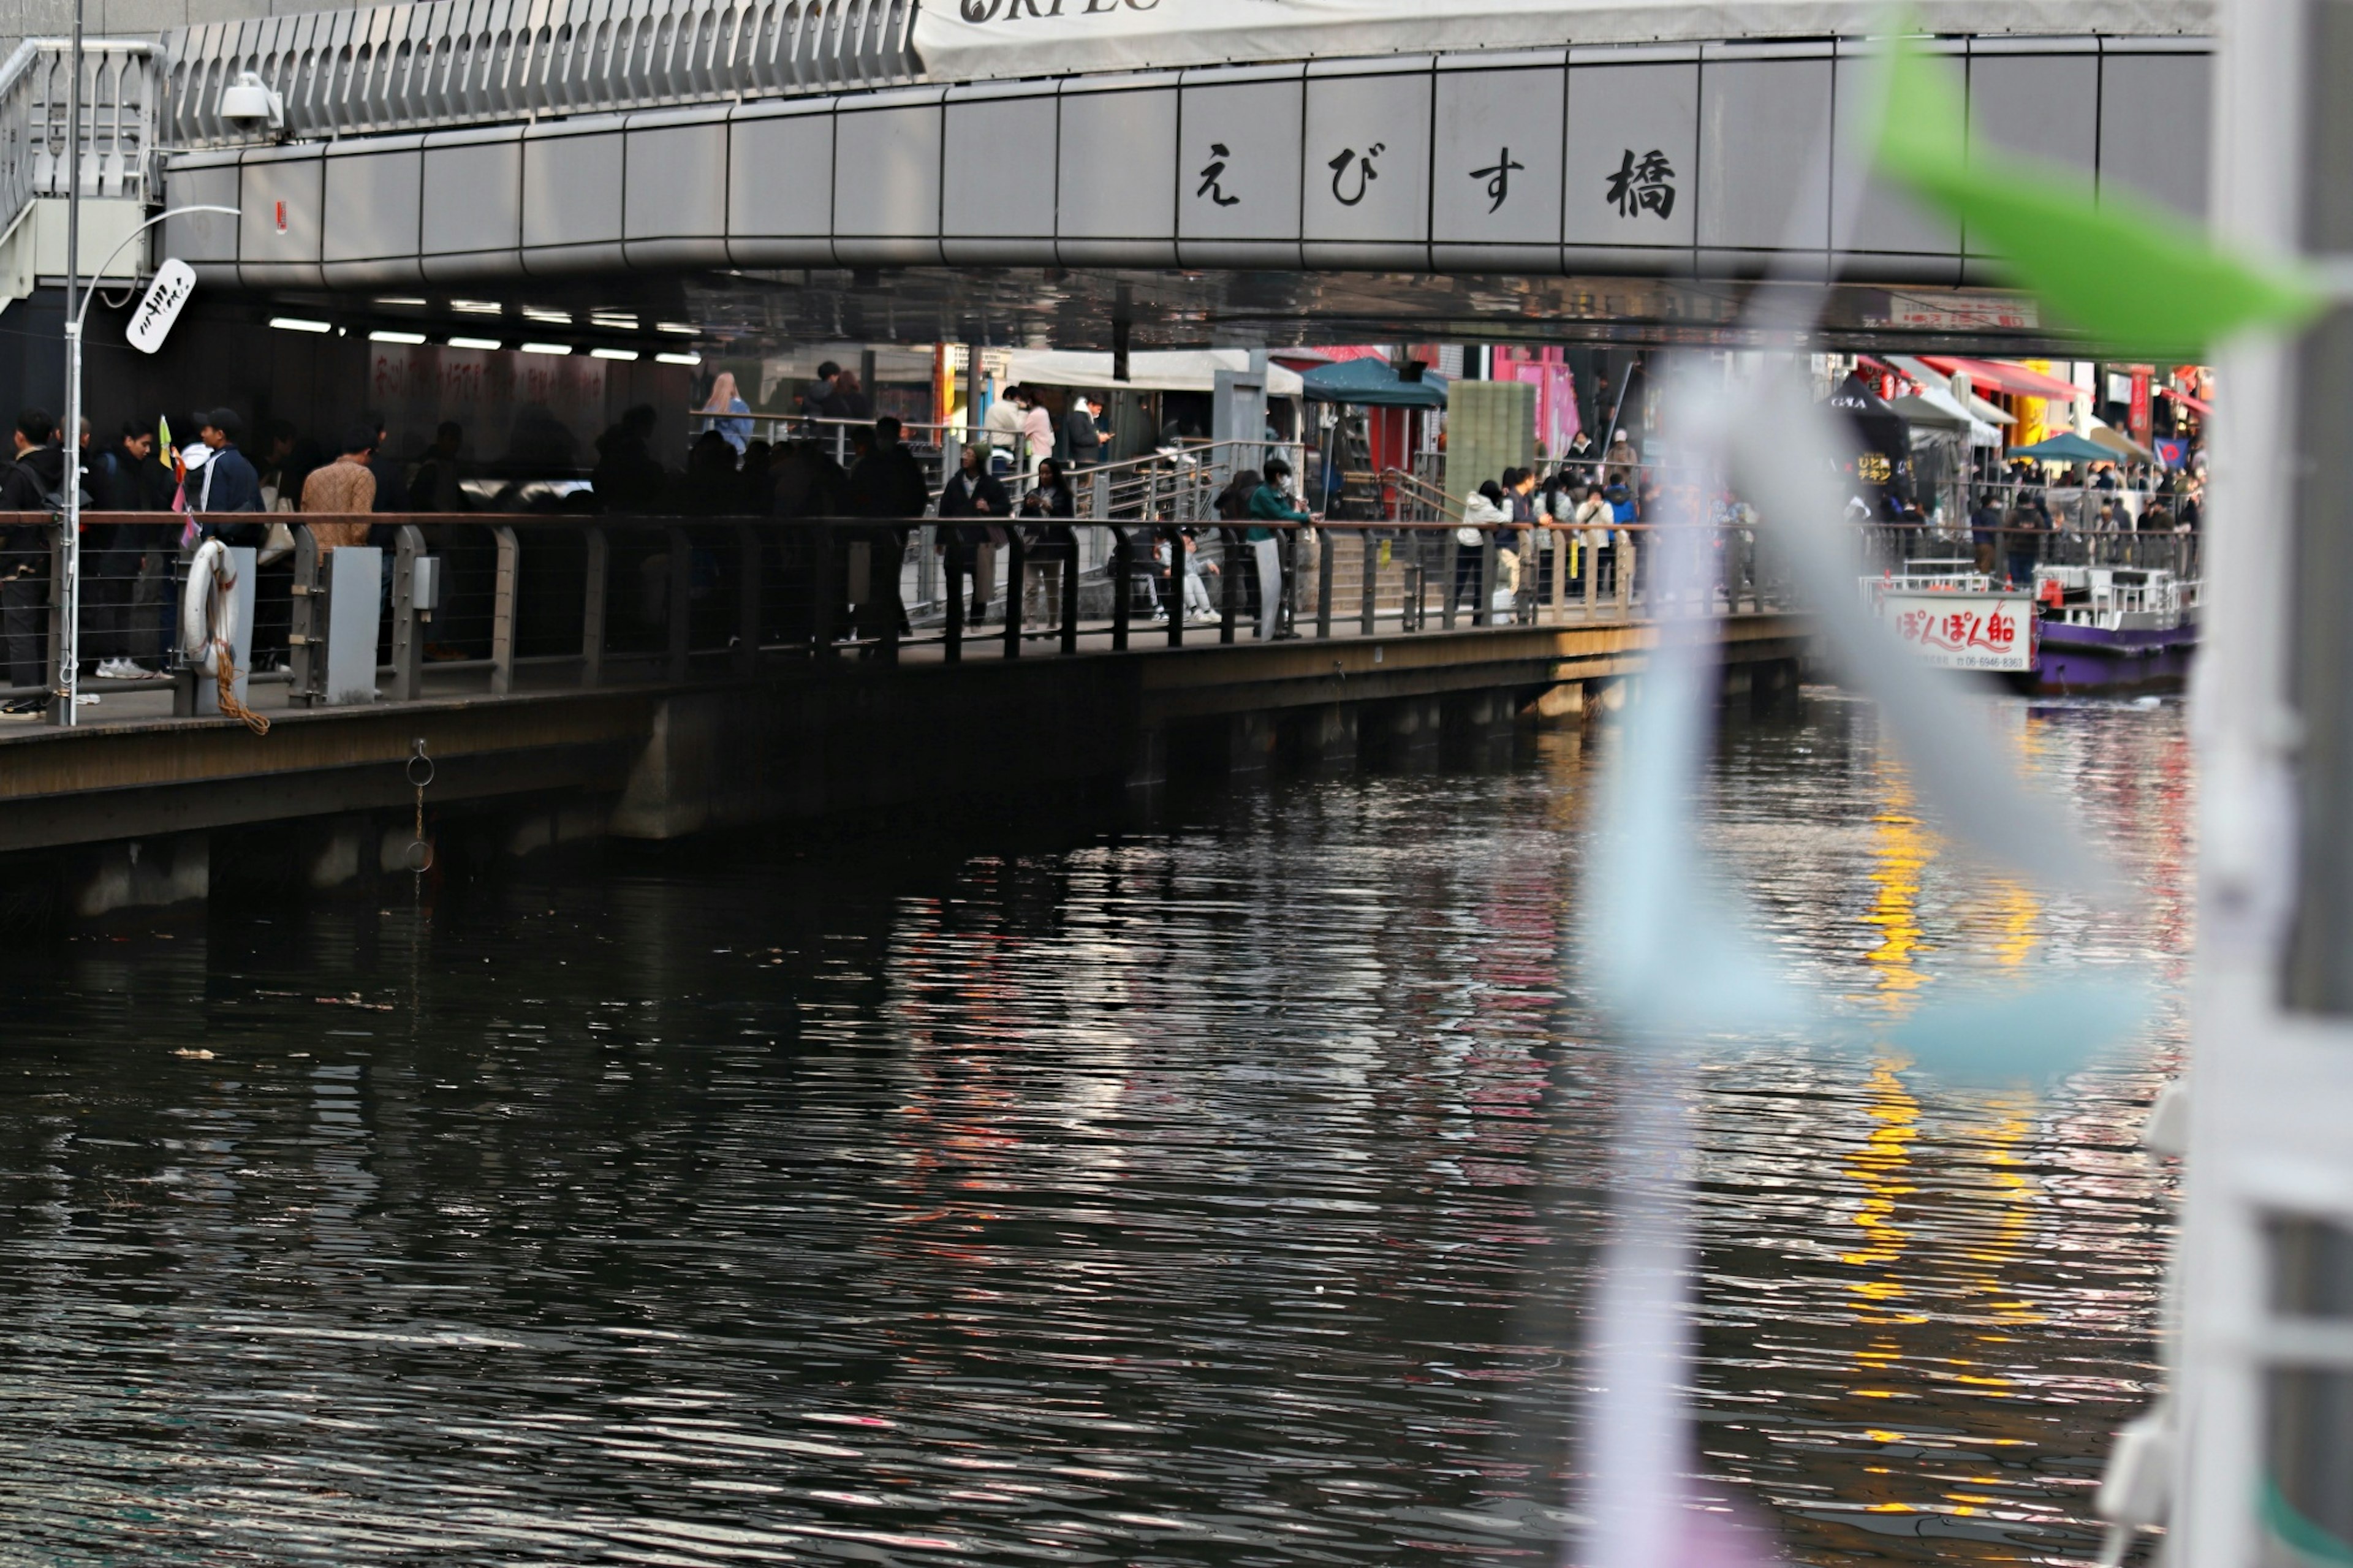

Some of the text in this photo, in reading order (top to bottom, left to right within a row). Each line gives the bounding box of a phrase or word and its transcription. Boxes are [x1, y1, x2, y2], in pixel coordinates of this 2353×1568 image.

[1197, 143, 1677, 219] えびす橋
[1896, 605, 2015, 653] ぽんぽん船
